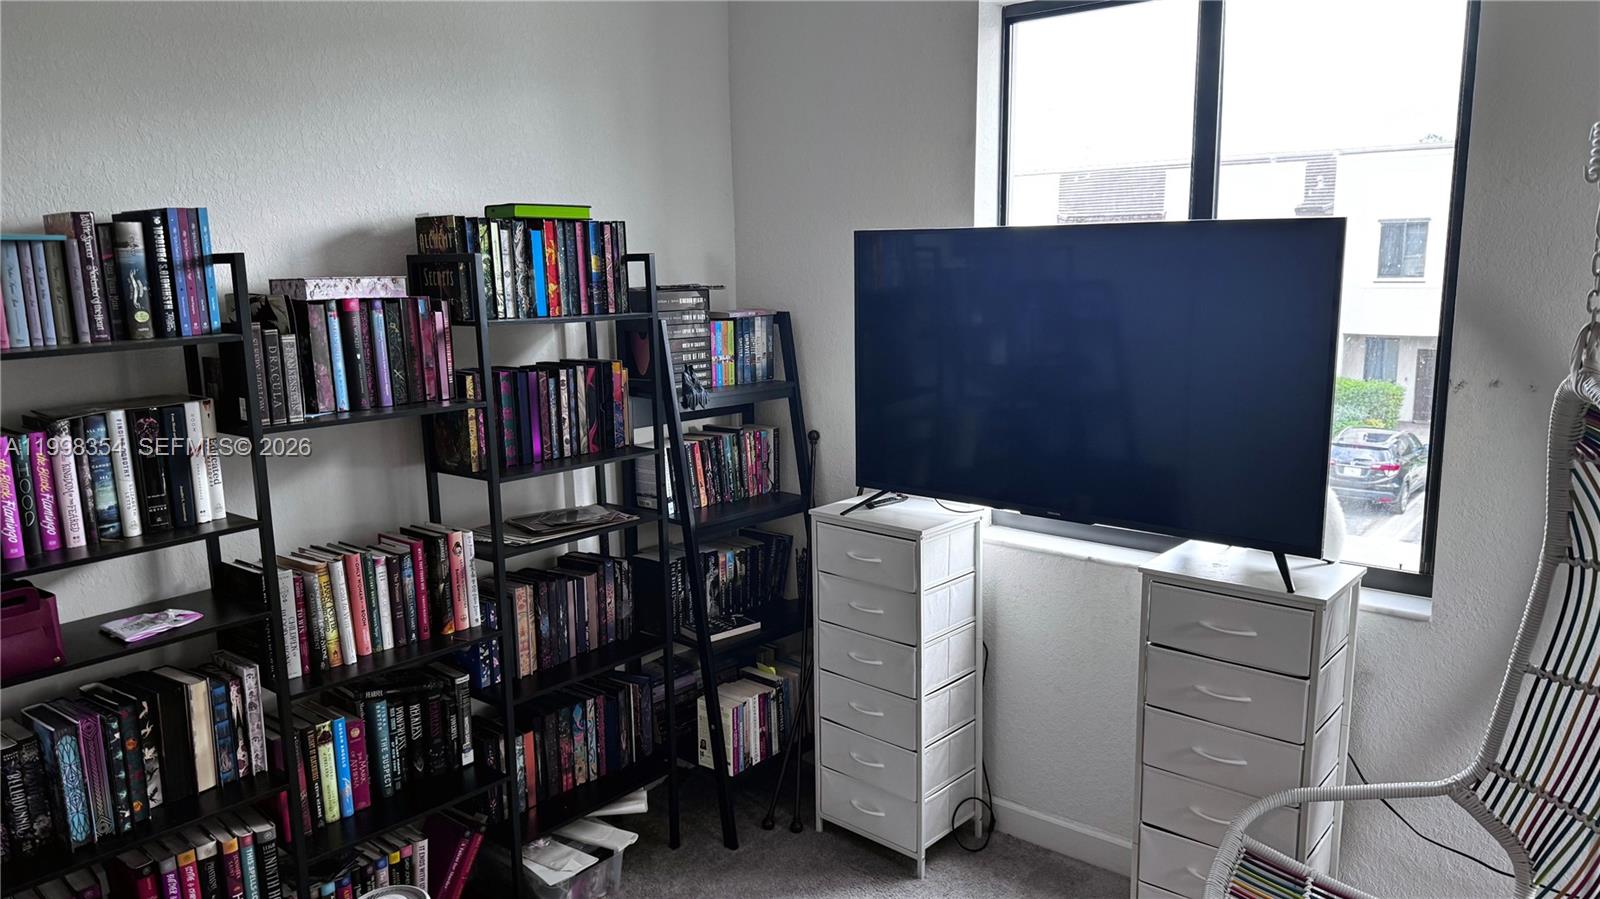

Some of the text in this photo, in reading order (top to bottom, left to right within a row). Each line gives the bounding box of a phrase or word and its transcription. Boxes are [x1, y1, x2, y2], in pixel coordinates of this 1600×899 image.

[153, 226, 168, 262] PROTOCOL
[420, 230, 453, 253] ALCHEMY
[423, 268, 454, 287] SECRETS
[94, 315, 104, 331] Heart
[268, 345, 281, 409] DRACULA
[284, 342, 300, 410] FRANKENSTEIN
[62, 461, 75, 496] KINGDOM
[120, 447, 131, 478] DOROTHY
[209, 437, 222, 486] Educated
[1, 473, 14, 501] Black
[36, 453, 57, 536] the Black Flamingo
[2, 499, 19, 543] Flamingo
[67, 504, 81, 534] FEARED
[288, 616, 298, 652] CHILDREN
[326, 607, 337, 634] POTTER
[396, 706, 407, 750] POWERLESS
[409, 703, 423, 741] RECKLESS
[380, 737, 393, 789] THE SUSPECT
[6, 769, 31, 838] BELLADONNA
[246, 847, 255, 866] THIS
[248, 866, 258, 891] SPELLS
